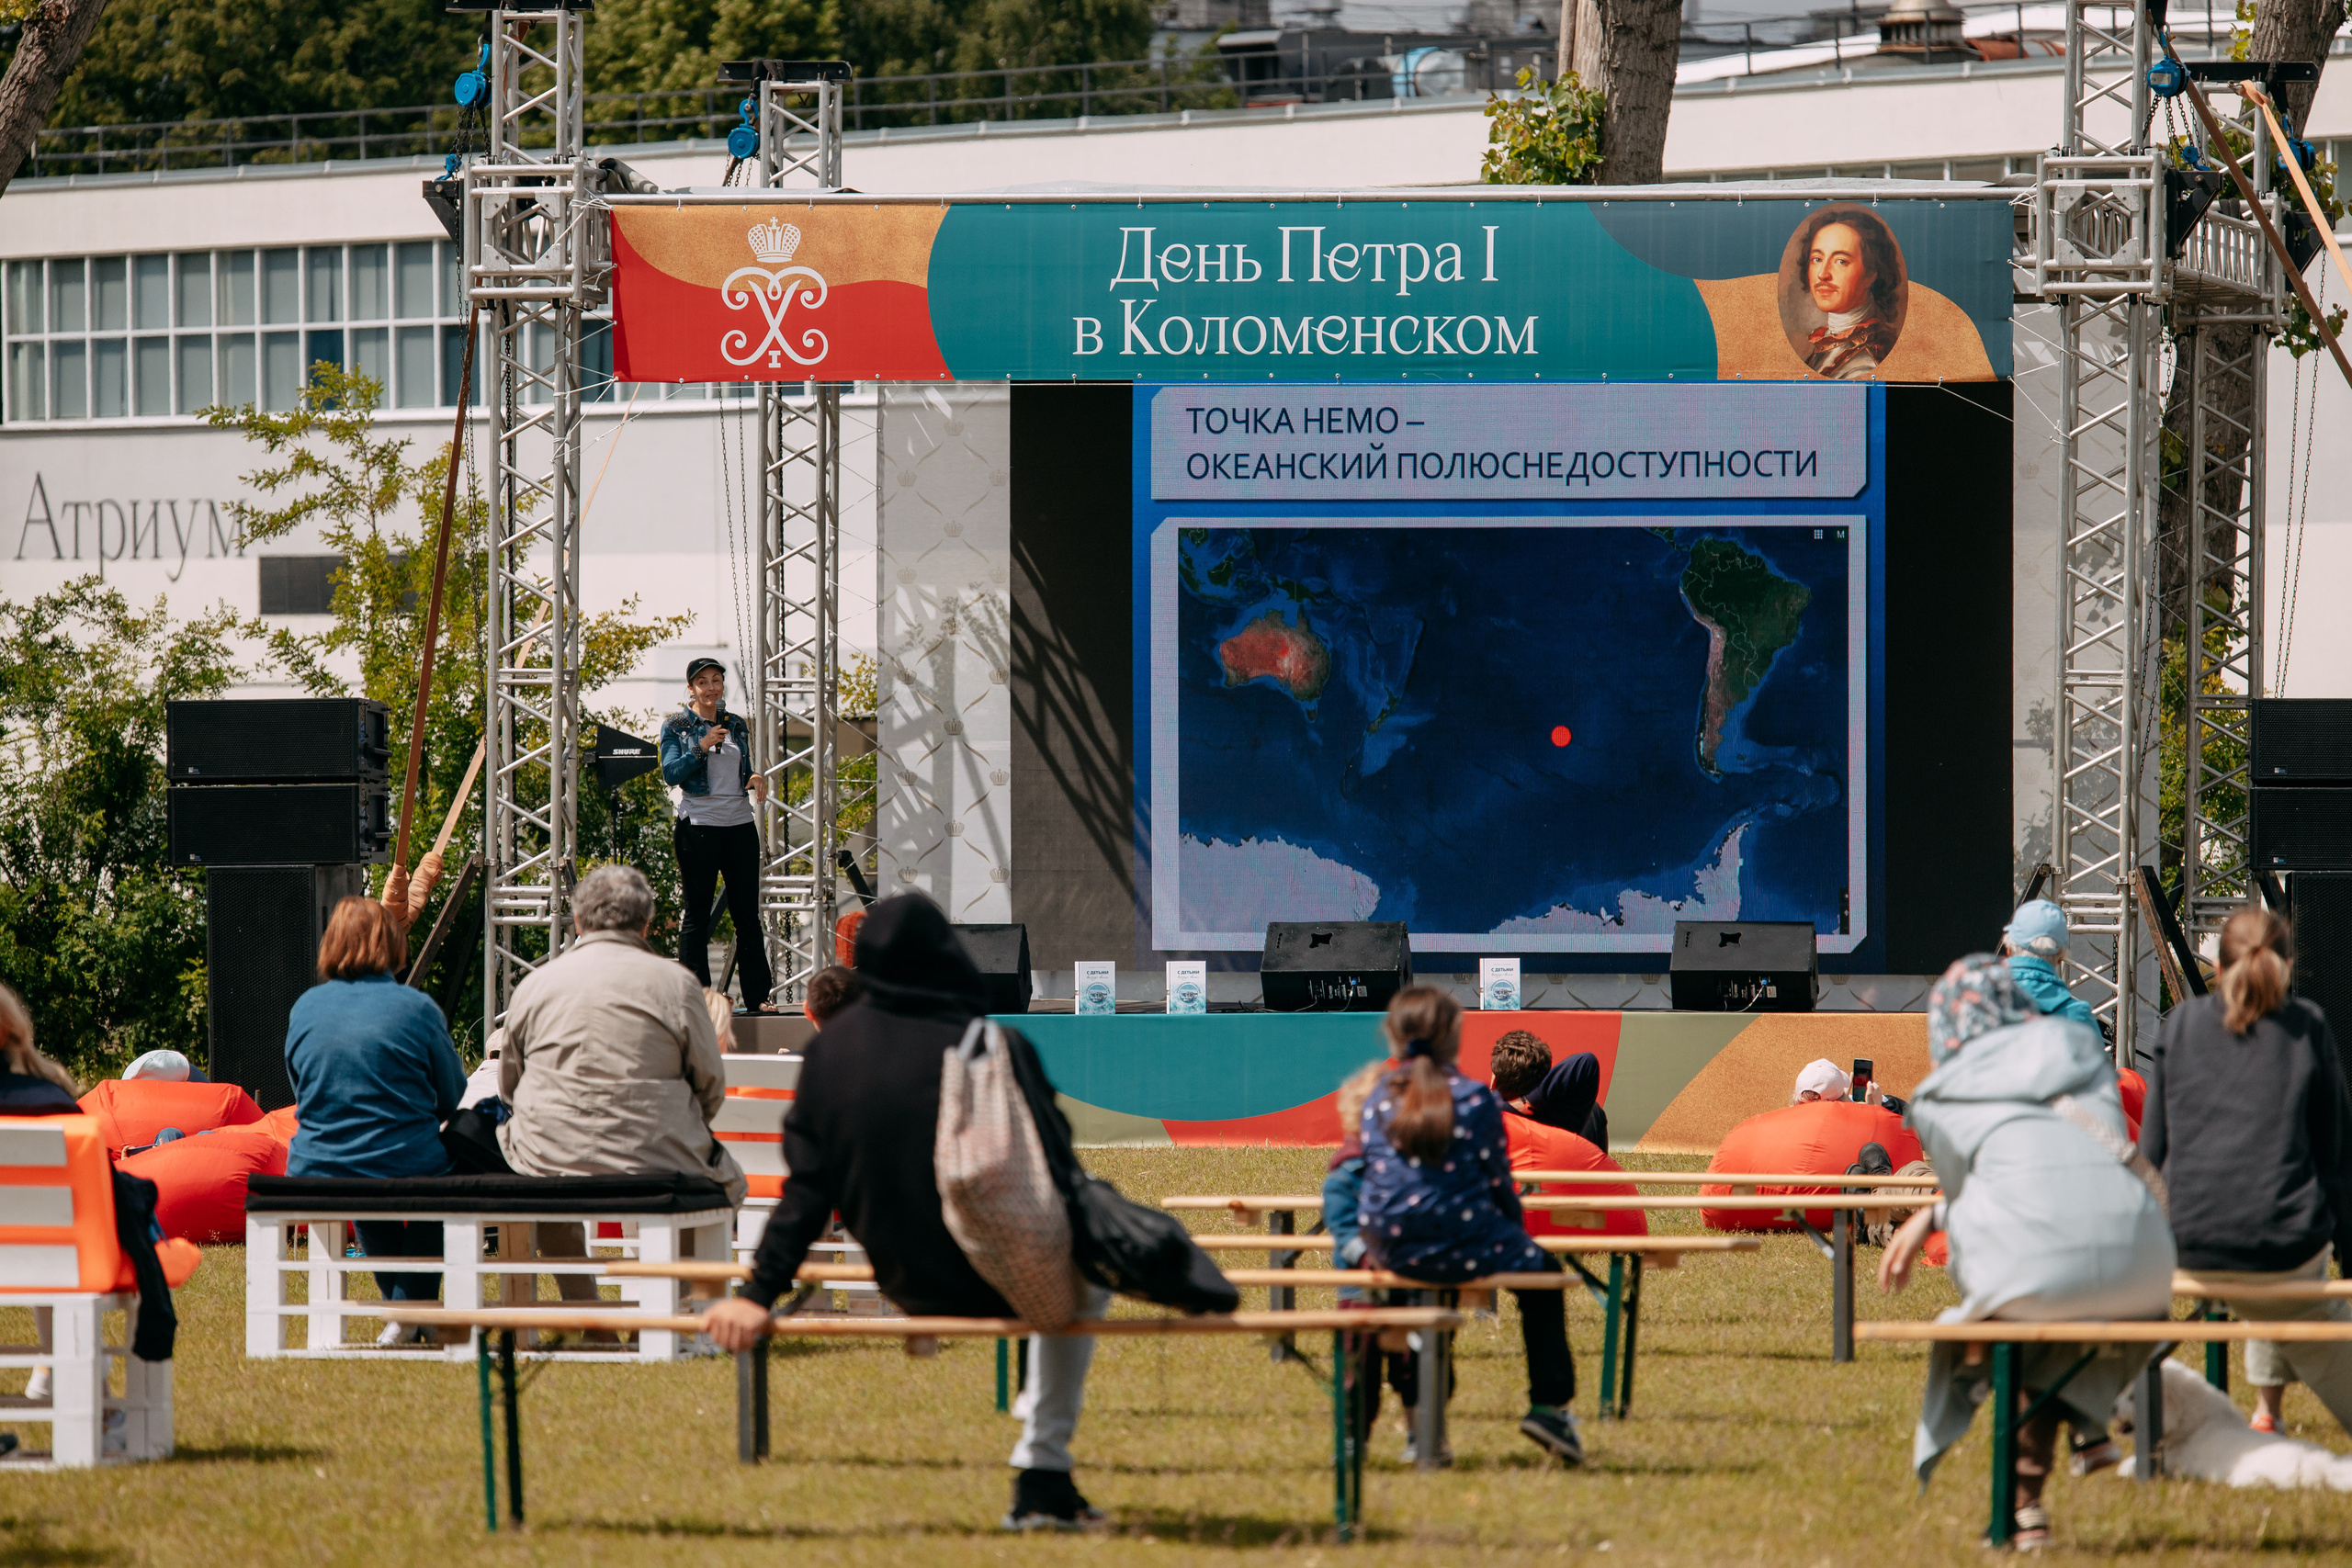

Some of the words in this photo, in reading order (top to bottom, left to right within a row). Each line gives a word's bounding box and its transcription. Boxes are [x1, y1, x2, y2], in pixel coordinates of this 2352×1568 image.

[1109, 227, 1262, 292] День
[1277, 226, 1465, 296] Петра
[1481, 225, 1499, 281] I
[1072, 317, 1103, 355] в
[1119, 299, 1539, 355] Коломенском
[1185, 407, 1295, 434] ТОЧКА
[1304, 406, 1399, 434] НЕМО
[1186, 442, 1387, 480] ОКЕАНСКИЙ
[14, 471, 246, 583] Атриум
